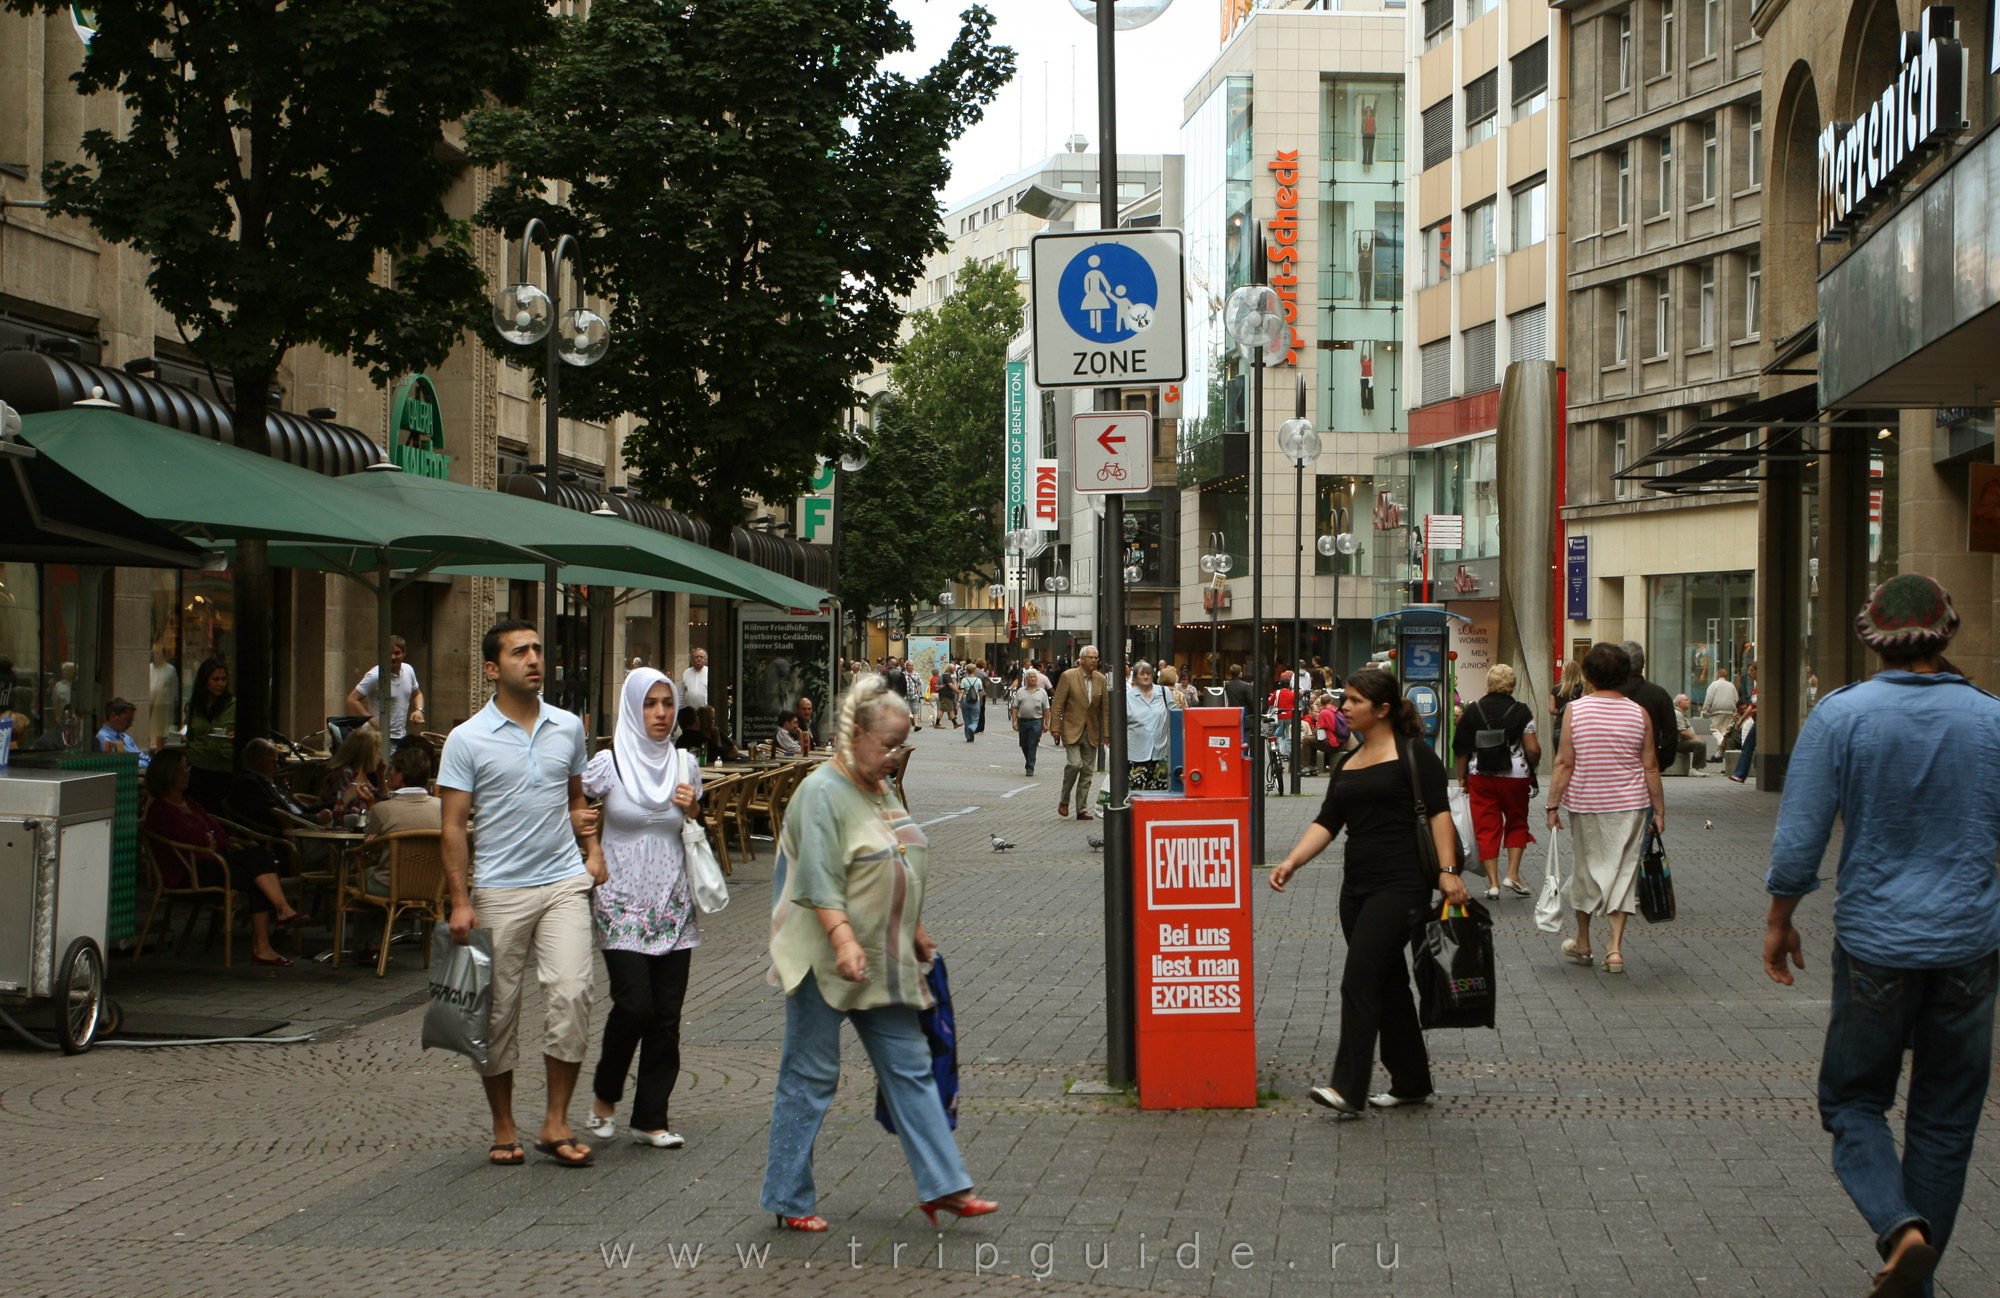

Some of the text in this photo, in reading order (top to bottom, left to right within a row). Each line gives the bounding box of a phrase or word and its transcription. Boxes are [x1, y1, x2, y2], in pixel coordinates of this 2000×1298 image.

[1816, 5, 1938, 243] Merzenich
[1072, 349, 1147, 376] ZONE
[1011, 368, 1022, 435] BENETTON.
[408, 396, 433, 435] GALERIA
[1011, 438, 1022, 455] OF
[1011, 456, 1022, 504] COLORS
[1036, 466, 1056, 523] KULT
[744, 623, 809, 632] Kölner Friedhöfe:
[782, 632, 824, 641] Gedächtnis
[1457, 623, 1487, 636] s.Oliver
[1412, 644, 1431, 667] 5
[1155, 837, 1231, 888] EXPRESS
[1159, 923, 1230, 946] Bei uns
[1152, 954, 1239, 976] liest man
[1151, 984, 1240, 1008] EXPRESS
